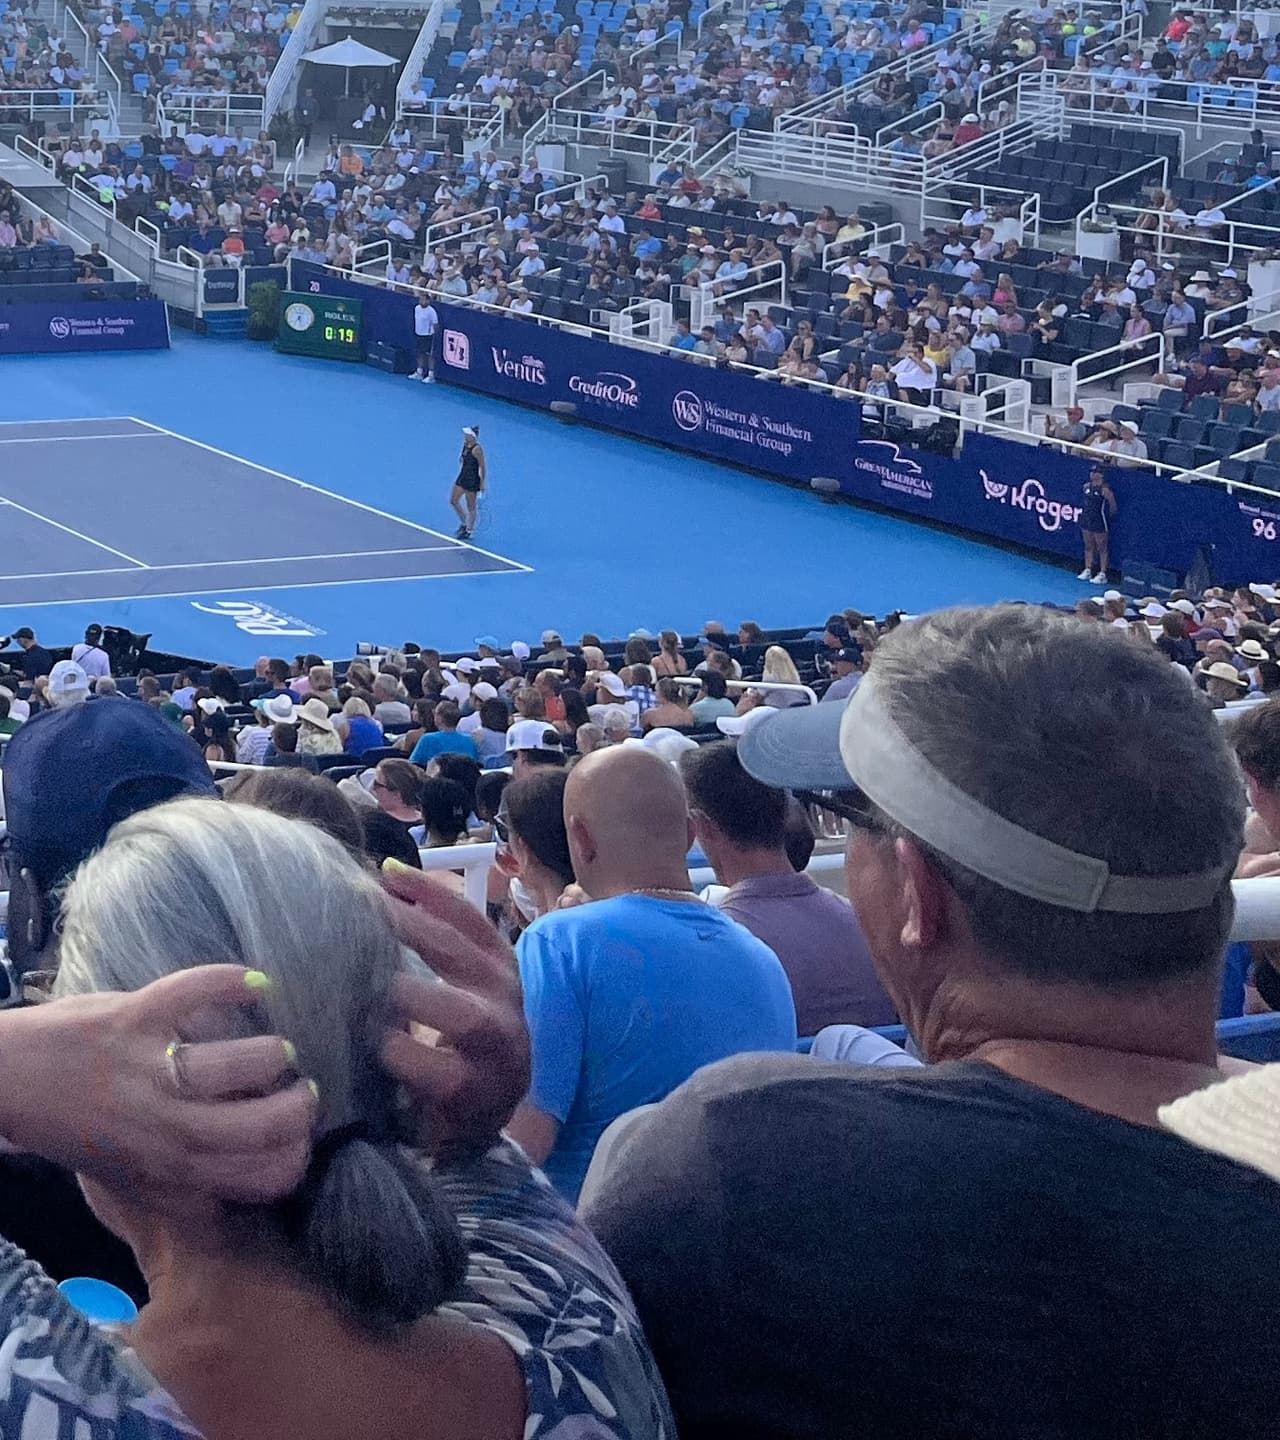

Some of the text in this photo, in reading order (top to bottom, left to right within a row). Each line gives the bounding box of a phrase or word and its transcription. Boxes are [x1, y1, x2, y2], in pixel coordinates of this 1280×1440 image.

[310, 281, 320, 292] 20
[324, 311, 356, 322] ROLEX
[325, 326, 354, 343] 0:19
[491, 347, 545, 385] Venus
[704, 399, 813, 442] Western & Southern
[705, 418, 792, 456] Financial Group
[1011, 479, 1083, 531] Kroger
[1252, 518, 1277, 540] 96
